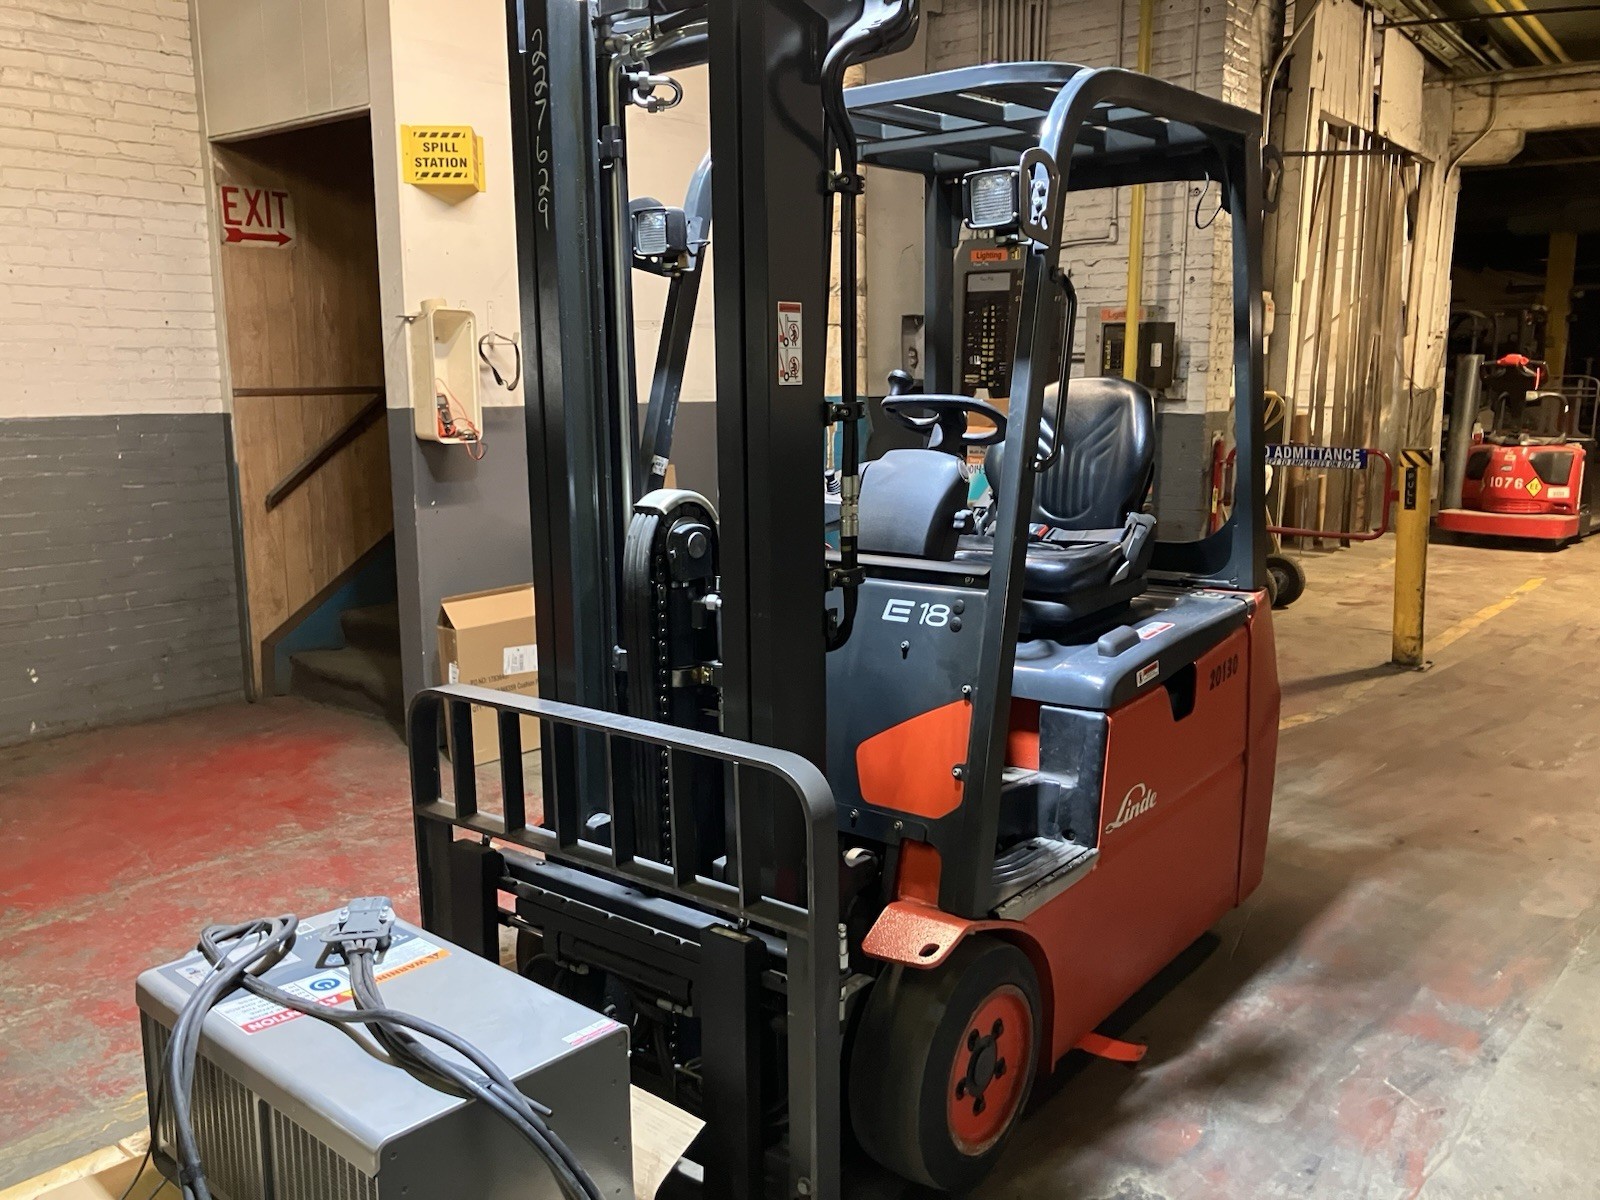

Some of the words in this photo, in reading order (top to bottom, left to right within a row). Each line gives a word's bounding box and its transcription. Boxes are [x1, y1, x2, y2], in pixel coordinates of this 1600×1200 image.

[423, 142, 459, 153] SPILL
[414, 157, 468, 168] STATION
[221, 186, 289, 229] EXIT
[976, 251, 1002, 261] Lighting
[1264, 445, 1271, 458] O
[1274, 446, 1361, 462] ADMITTANCE
[1490, 476, 1524, 490] 1076
[882, 598, 916, 623] E
[919, 602, 951, 627] 18
[1105, 782, 1158, 835] Linde
[375, 959, 428, 982] WARNIN
